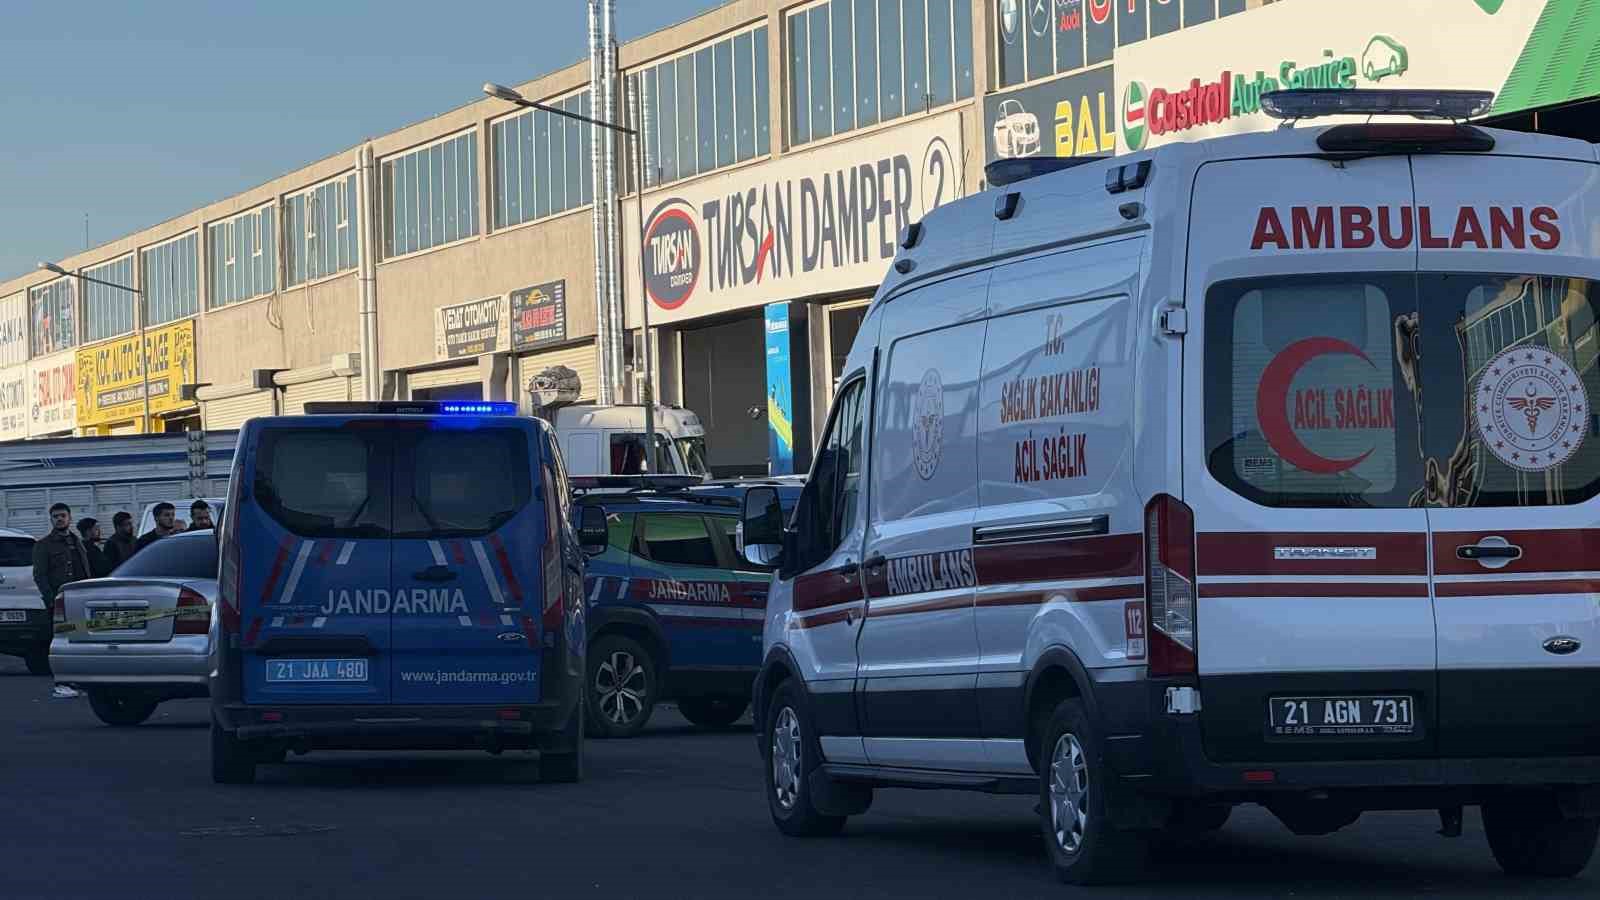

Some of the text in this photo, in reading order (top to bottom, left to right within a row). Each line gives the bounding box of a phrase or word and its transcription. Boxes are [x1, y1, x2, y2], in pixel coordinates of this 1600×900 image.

[1148, 71, 1231, 136] Castrol
[802, 154, 912, 272] DAMPER
[929, 148, 944, 208] 2
[1250, 206, 1561, 249] AMBULANS
[1040, 362, 1100, 417] BAKANLIĞI
[1295, 384, 1394, 429] ACİL SAĞLIK
[1014, 425, 1087, 483] ACİL SAĞLIK
[649, 579, 731, 602] JANDARMA
[886, 549, 975, 595] AMBULANS
[321, 588, 469, 614] JANDARMA
[1127, 608, 1143, 635] 112
[277, 661, 364, 679] 21 JAA 480
[401, 669, 537, 684] www.jandarma.gov.tr
[1284, 699, 1409, 725] 21 AGN 731
